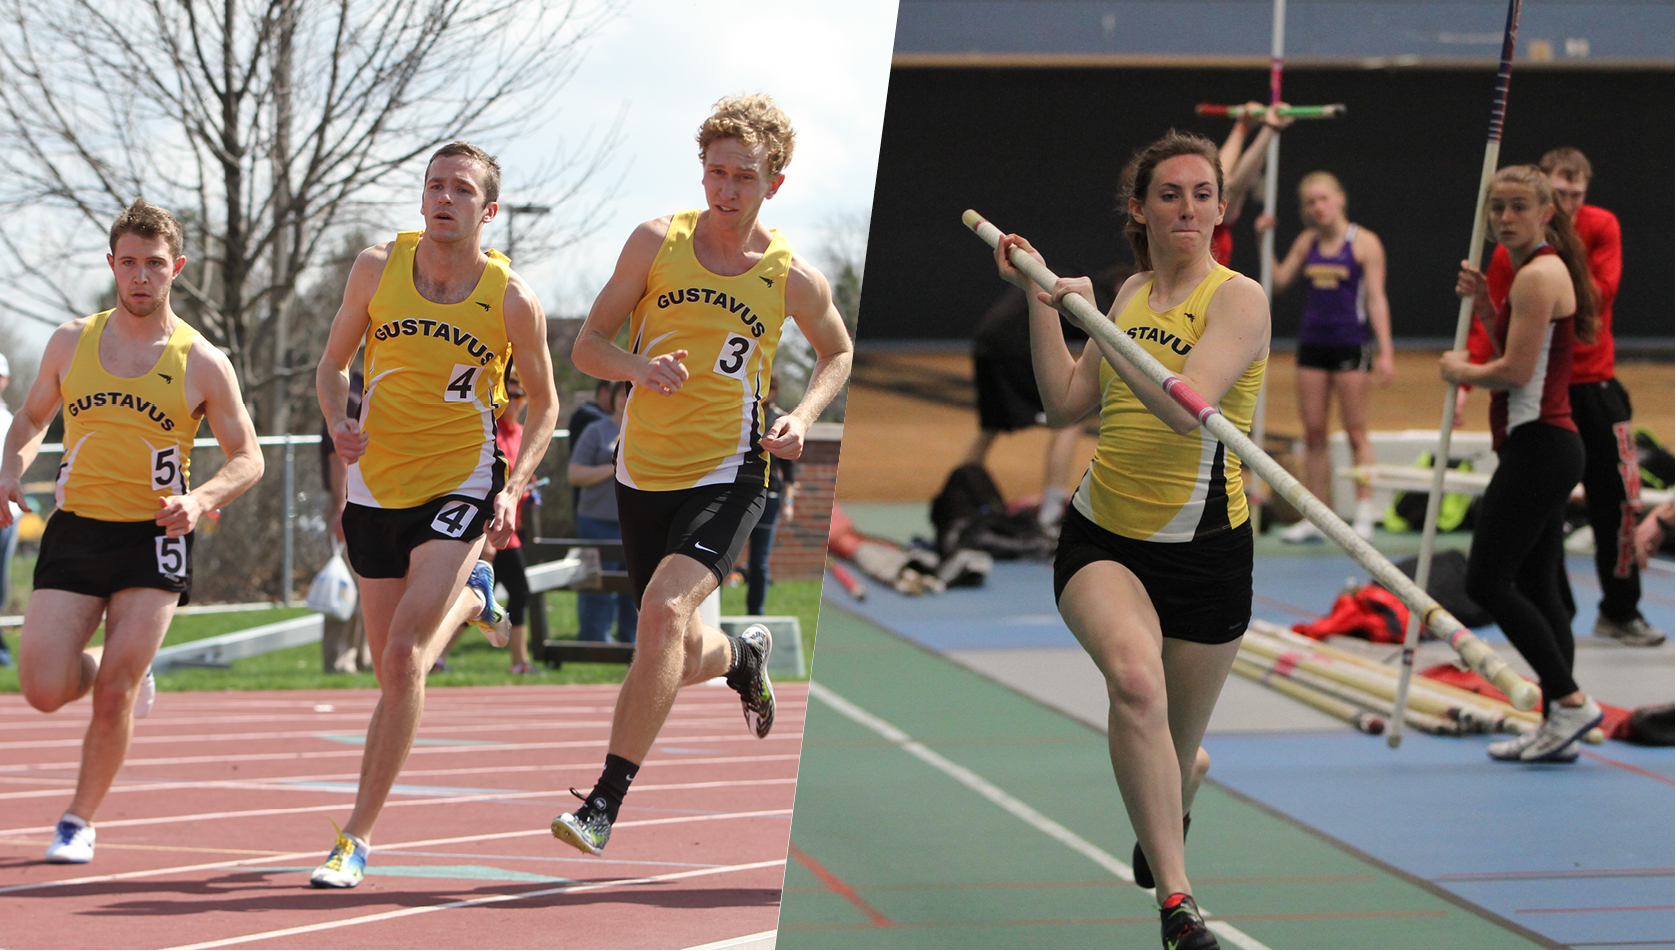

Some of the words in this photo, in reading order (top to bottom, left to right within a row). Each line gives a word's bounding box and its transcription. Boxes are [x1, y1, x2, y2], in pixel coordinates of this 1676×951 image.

[655, 287, 766, 338] GUSTAVUS
[374, 318, 495, 366] GUSTAVUS
[719, 336, 750, 374] 3
[1124, 326, 1193, 356] STAVU
[446, 367, 477, 399] 4
[68, 391, 175, 432] GUSTAVUS
[154, 448, 176, 486] 5
[437, 503, 471, 534] 4
[161, 537, 182, 574] 5
